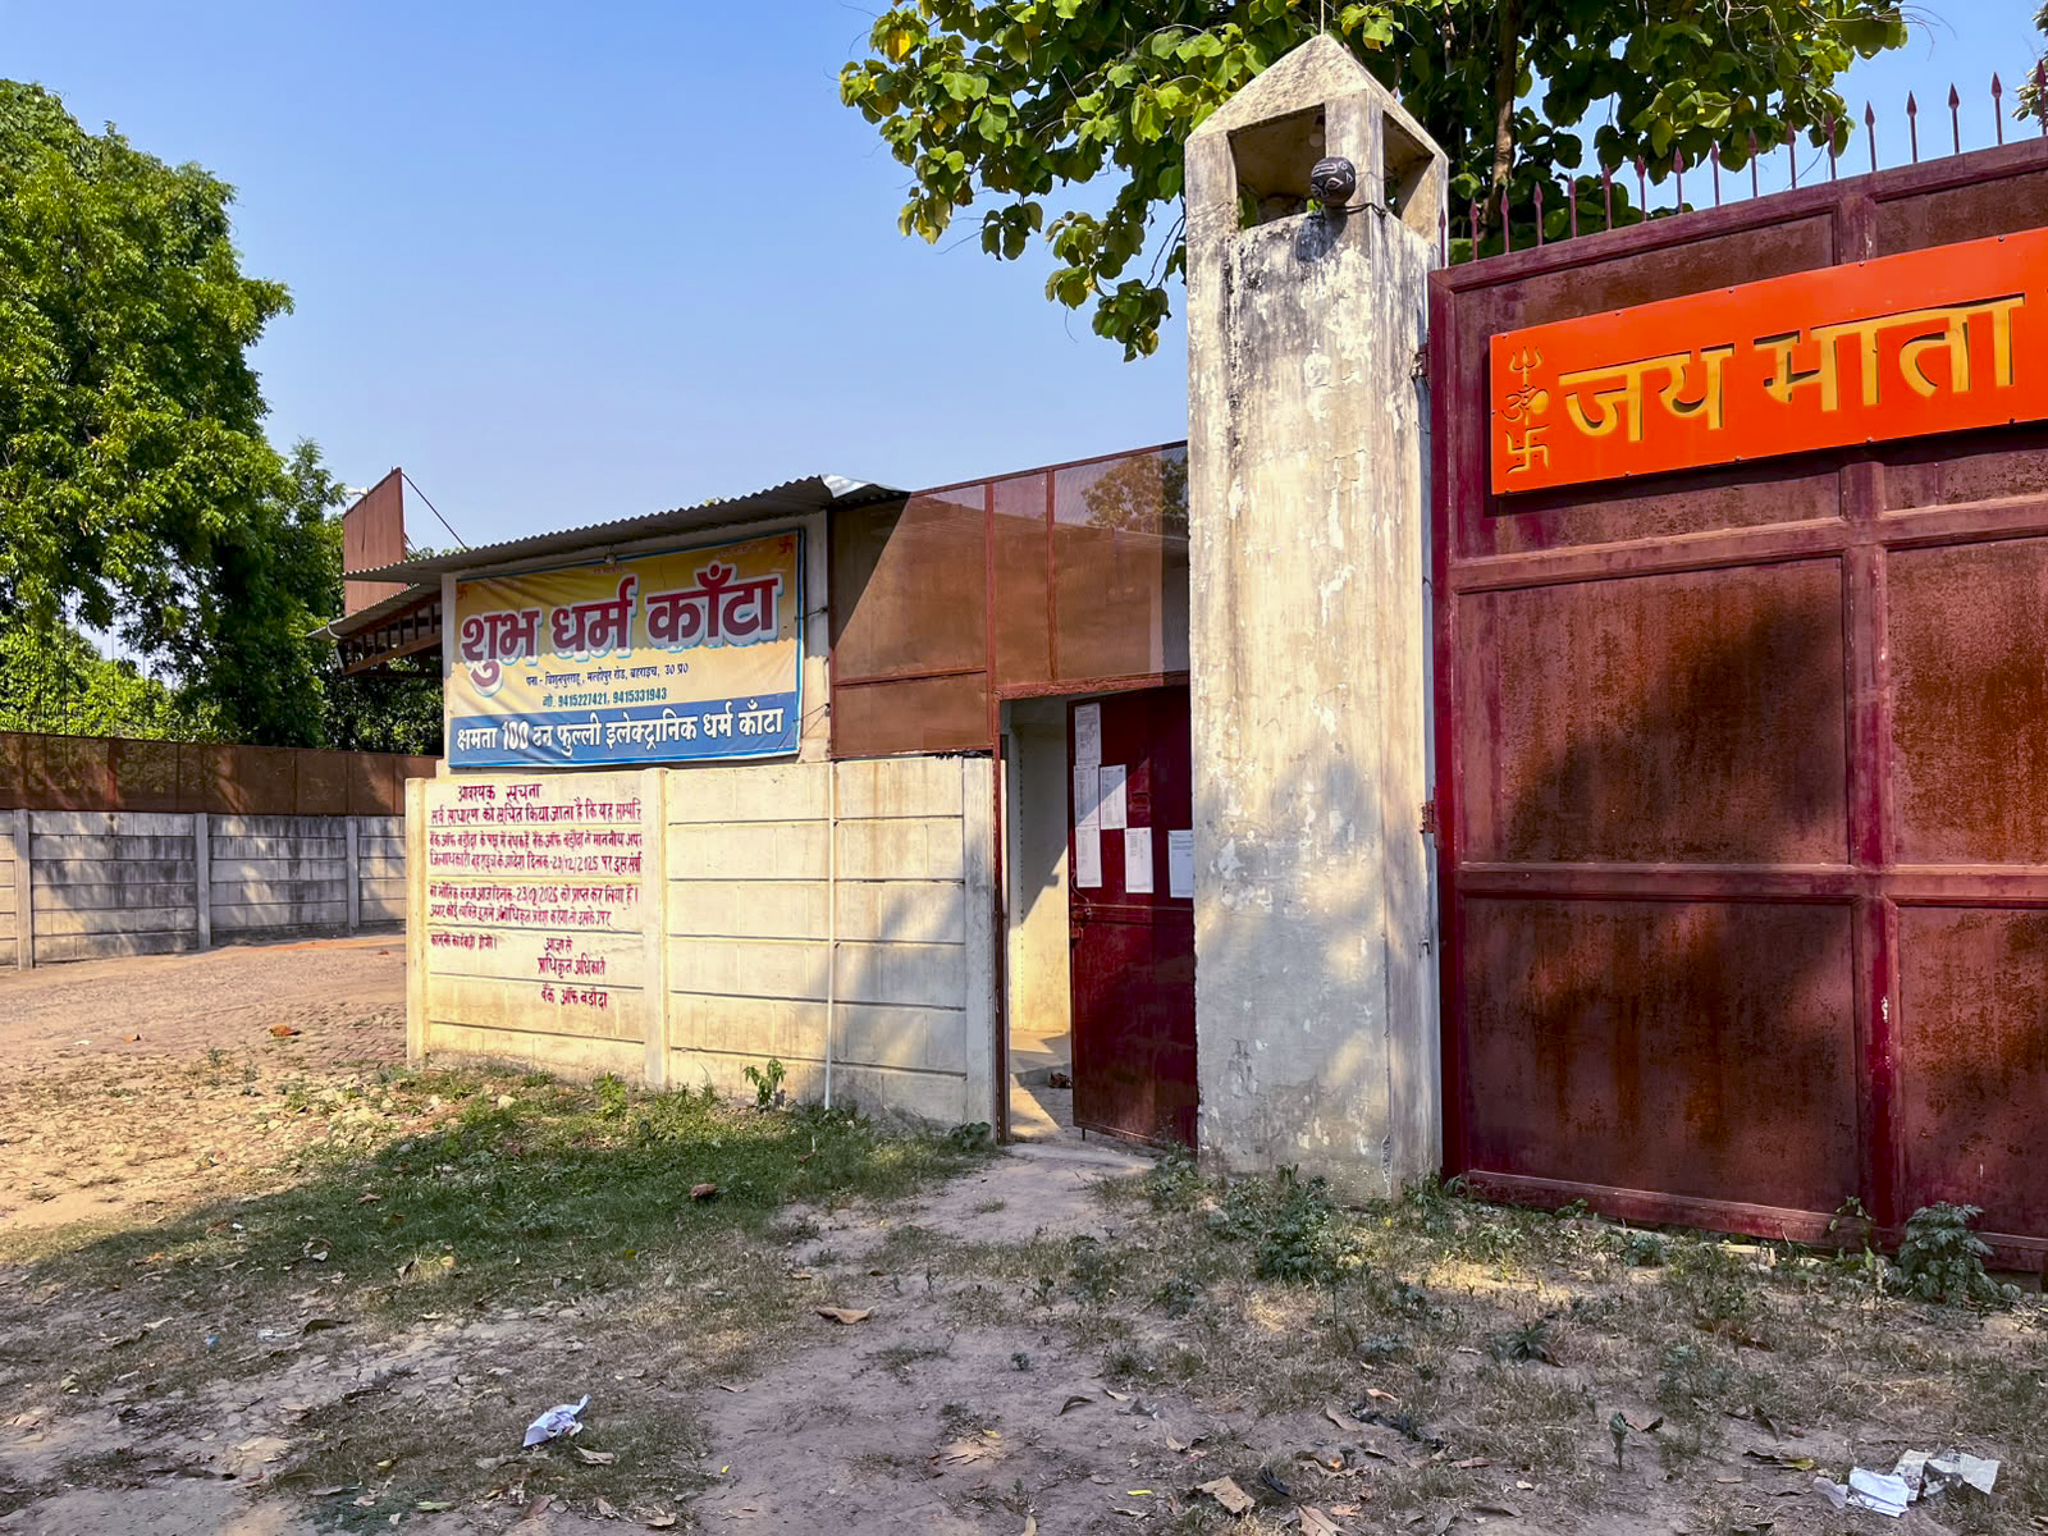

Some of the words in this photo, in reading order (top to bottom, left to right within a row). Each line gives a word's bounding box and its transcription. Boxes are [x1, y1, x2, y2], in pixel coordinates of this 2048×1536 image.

[1559, 343, 1735, 442] जय
[1753, 293, 2025, 412] माता
[461, 609, 540, 688] शुभ
[551, 574, 638, 652] धर्म
[646, 563, 780, 643] काँटा
[612, 687, 668, 703] 9415331943
[457, 727, 498, 751] क्षमता
[502, 721, 530, 750] 100
[532, 725, 554, 747] टन
[557, 711, 602, 757] फुल्ली
[606, 707, 699, 750] इलेक्ट्रानिक
[703, 701, 734, 738] धर्म
[738, 698, 784, 736] काँटा
[506, 783, 543, 803] सूचना
[525, 802, 549, 822] किया
[550, 805, 574, 822] जाता
